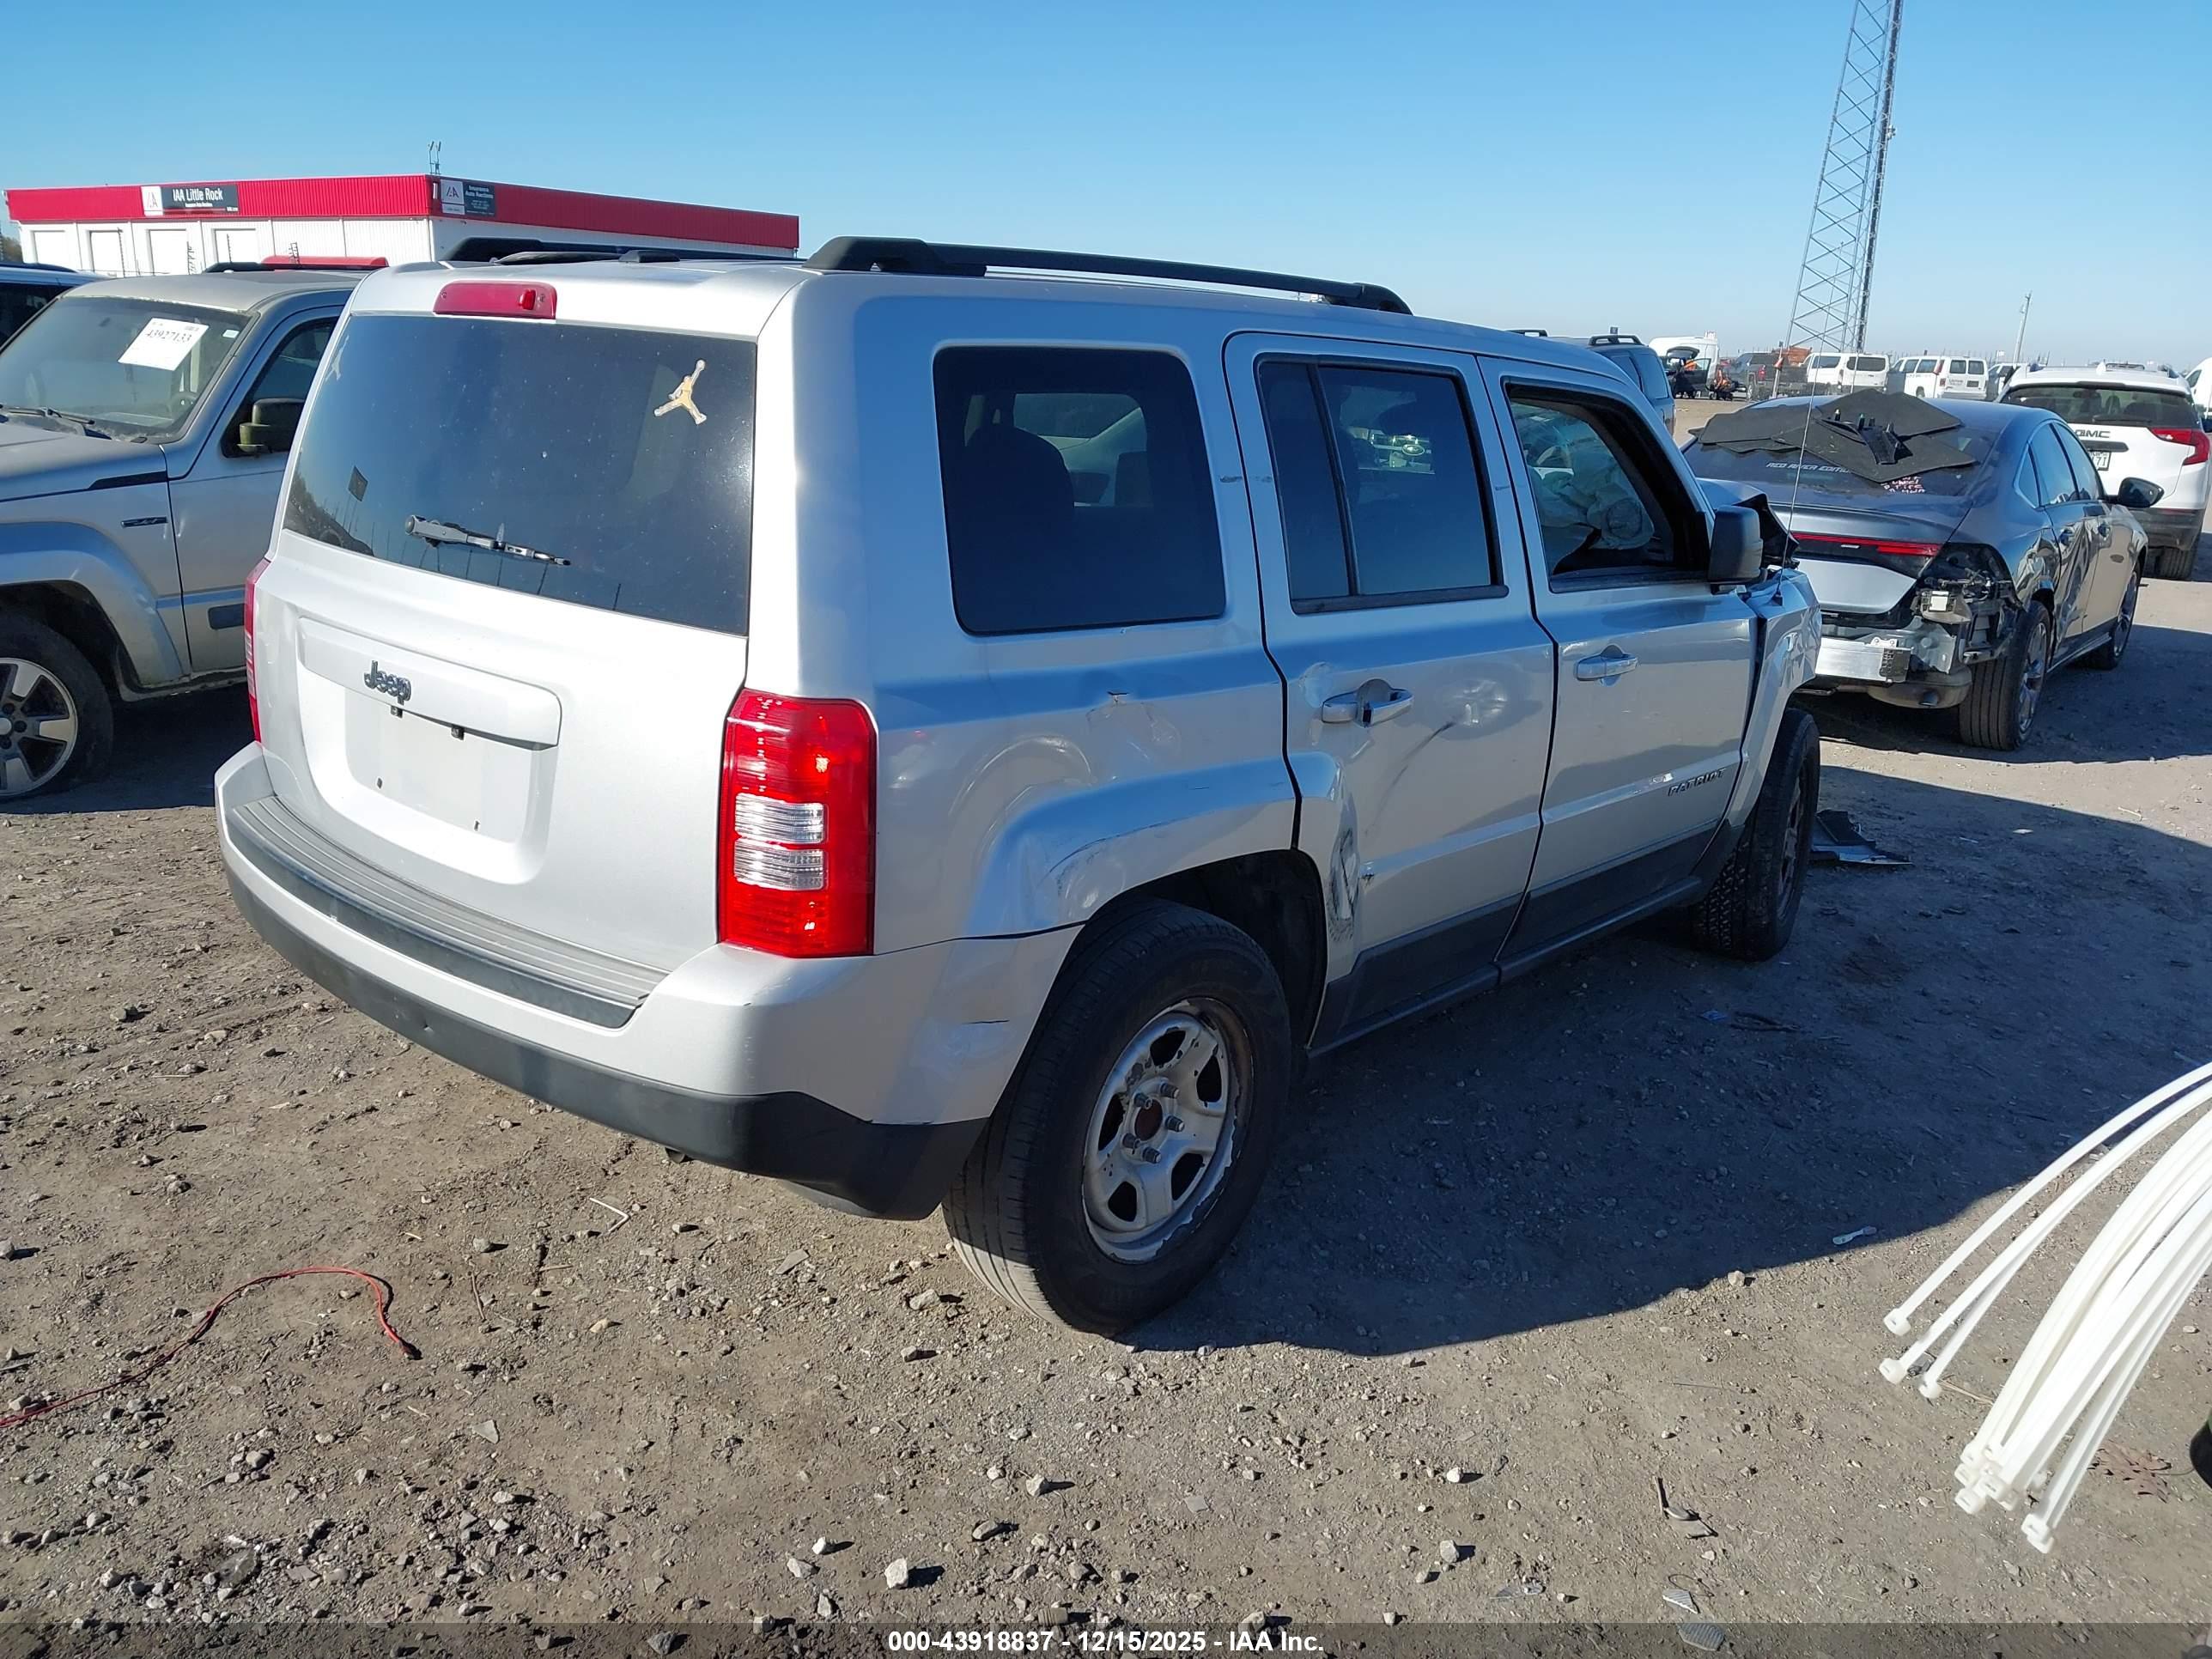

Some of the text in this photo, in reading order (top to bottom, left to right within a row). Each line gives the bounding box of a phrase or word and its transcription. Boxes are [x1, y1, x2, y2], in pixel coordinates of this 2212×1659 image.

[172, 187, 224, 202] IAA Little Rock
[2075, 429, 2112, 439] GMC
[1818, 465, 1851, 474] EDITIO
[363, 659, 412, 706] Jeep
[1668, 768, 1727, 797] PATRIOT
